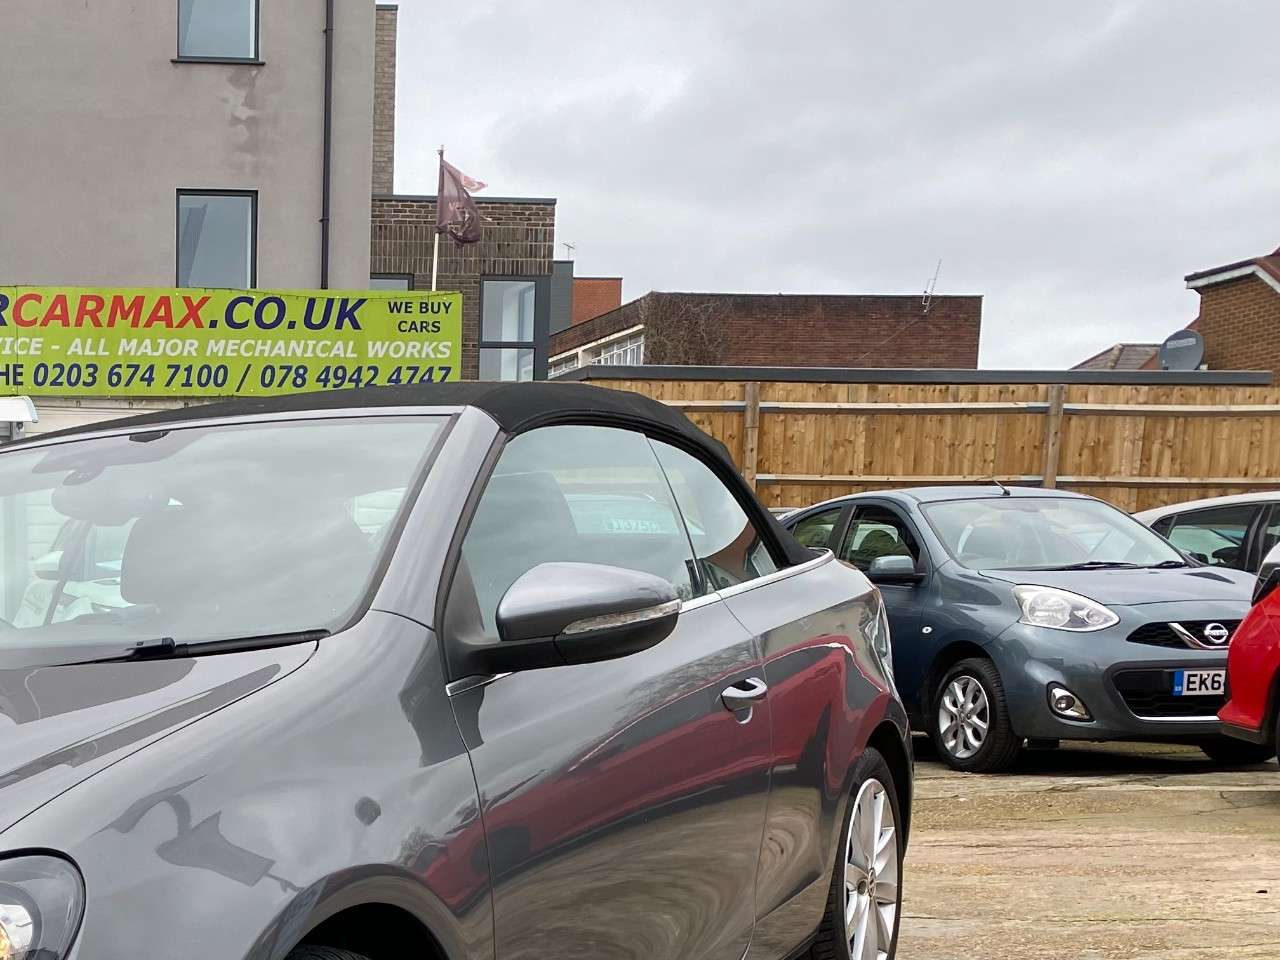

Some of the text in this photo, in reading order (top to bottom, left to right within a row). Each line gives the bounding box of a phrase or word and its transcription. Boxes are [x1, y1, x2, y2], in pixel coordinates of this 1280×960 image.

[388, 301, 452, 314] WE BUY
[398, 320, 441, 333] CARS
[67, 337, 110, 356] ALL
[118, 338, 199, 357] MAJOR
[206, 339, 358, 359] MECHANICAL
[367, 340, 452, 359] WORKS
[33, 363, 98, 387] 0203
[107, 363, 155, 387] 674
[165, 364, 228, 388] 7100
[235, 363, 251, 392] /
[260, 364, 308, 388] 078
[315, 365, 379, 389] 4942
[387, 366, 452, 386] 4747
[1186, 673, 1224, 692] EK6
